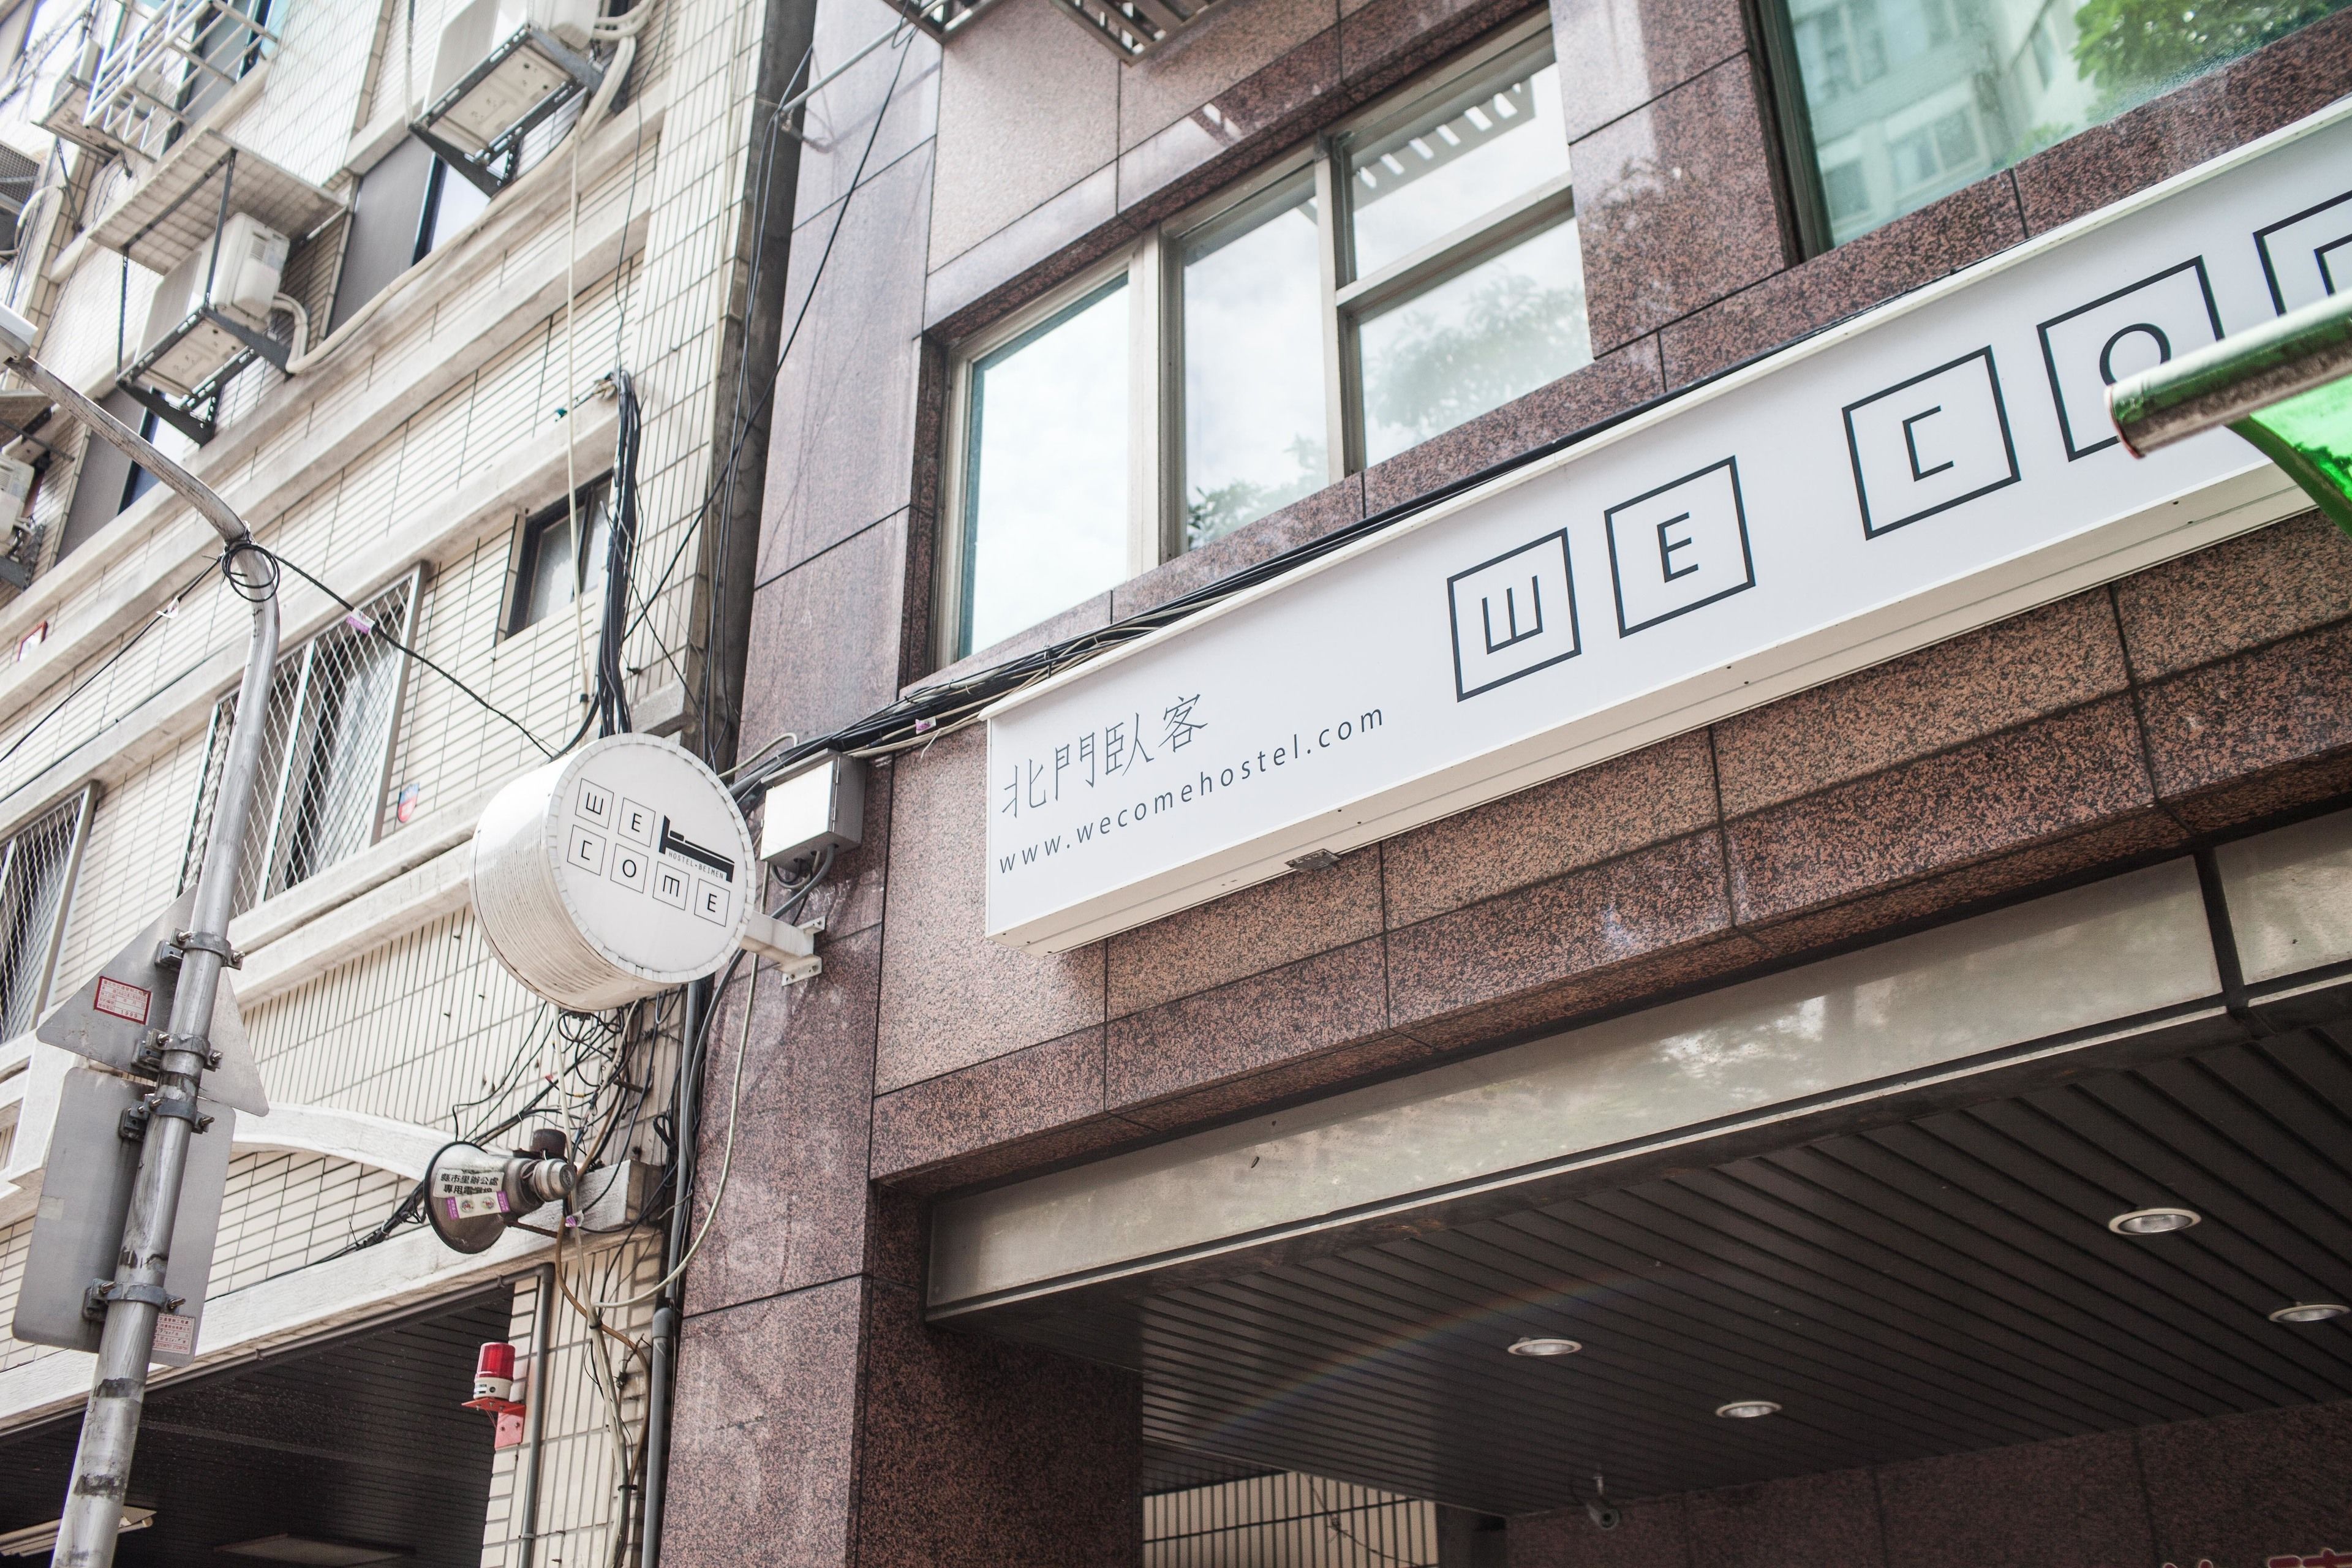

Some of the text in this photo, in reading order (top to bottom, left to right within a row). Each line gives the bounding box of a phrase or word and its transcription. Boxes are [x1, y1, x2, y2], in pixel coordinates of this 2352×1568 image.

[999, 707, 1384, 874] www.wecomehostel.com
[1001, 693, 1208, 819] 北門臥客
[582, 839, 718, 913] COME
[121, 1009, 138, 1019] 1999
